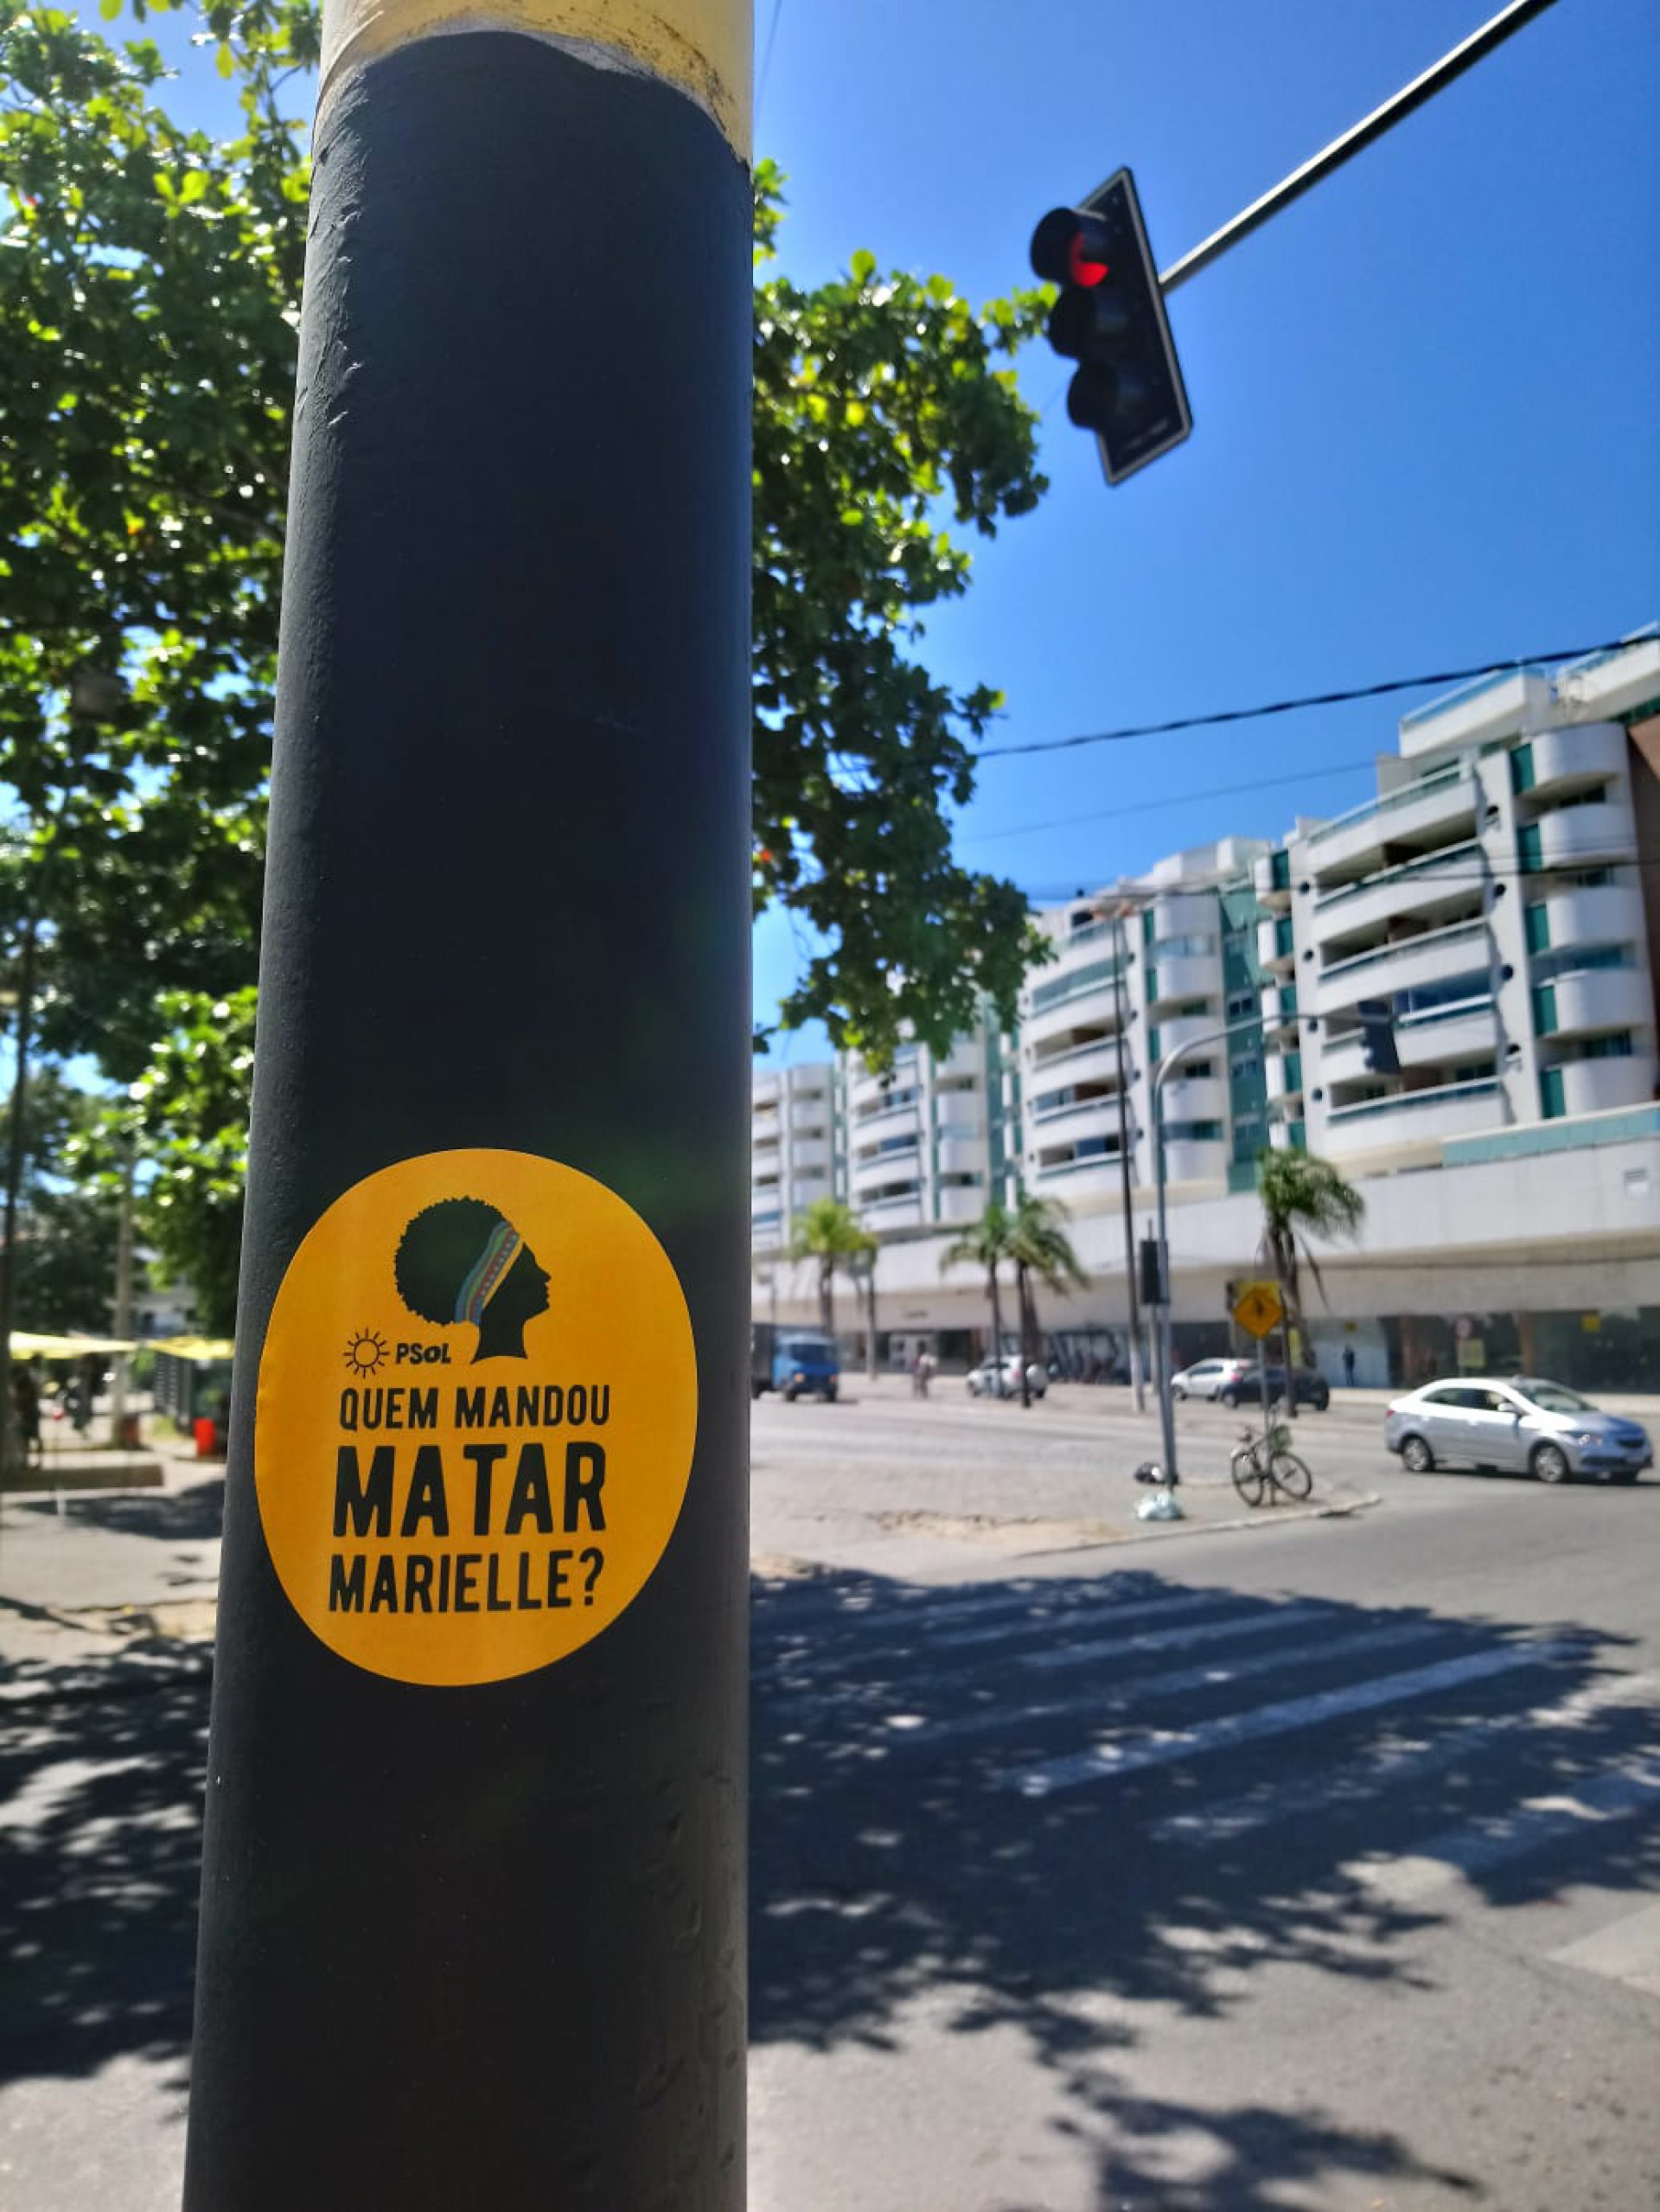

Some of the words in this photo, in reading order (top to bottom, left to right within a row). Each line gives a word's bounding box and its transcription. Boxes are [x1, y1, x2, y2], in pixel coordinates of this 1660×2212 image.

[339, 1387, 439, 1431] QUEM
[454, 1384, 610, 1429] MANDOU
[332, 1441, 607, 1538] MATAR
[328, 1546, 605, 1614] MARIELLE?
